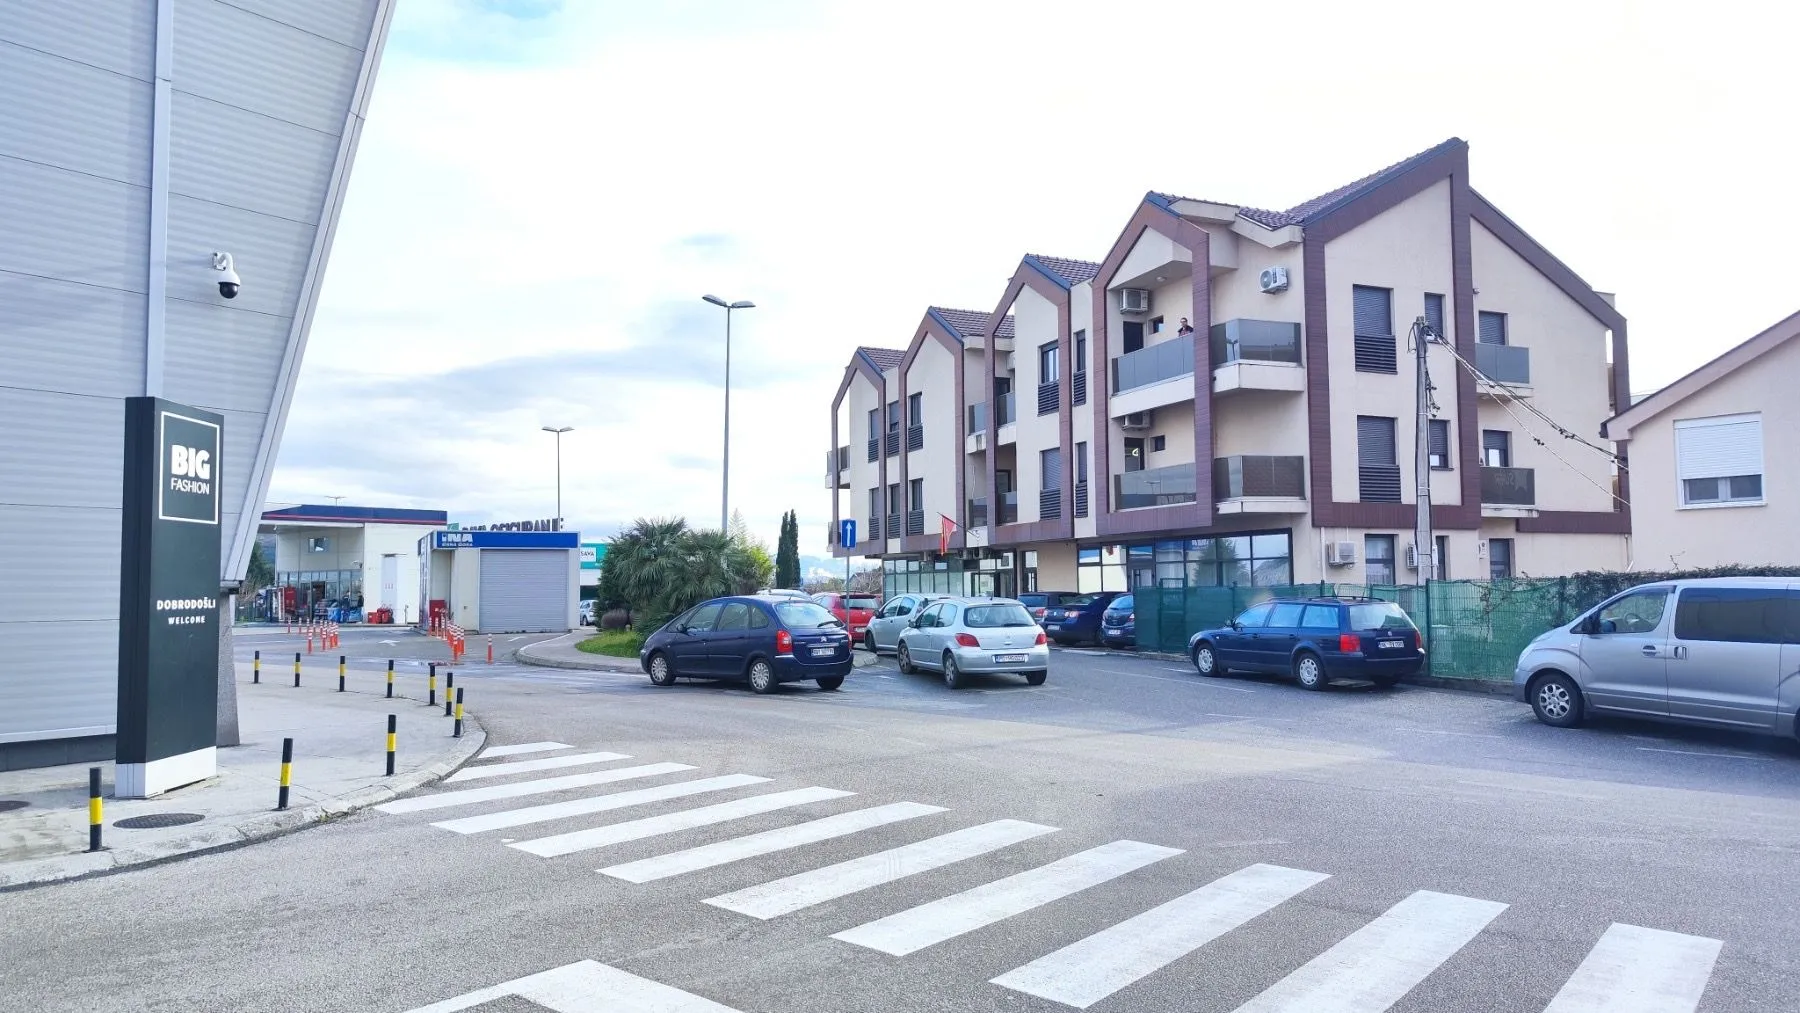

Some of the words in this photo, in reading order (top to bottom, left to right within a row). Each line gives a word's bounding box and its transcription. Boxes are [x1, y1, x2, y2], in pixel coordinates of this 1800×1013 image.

[171, 444, 211, 480] BIG
[170, 477, 210, 495] FASHION
[156, 596, 216, 611] DOBRODOŠLI
[167, 615, 206, 625] WELCOME
